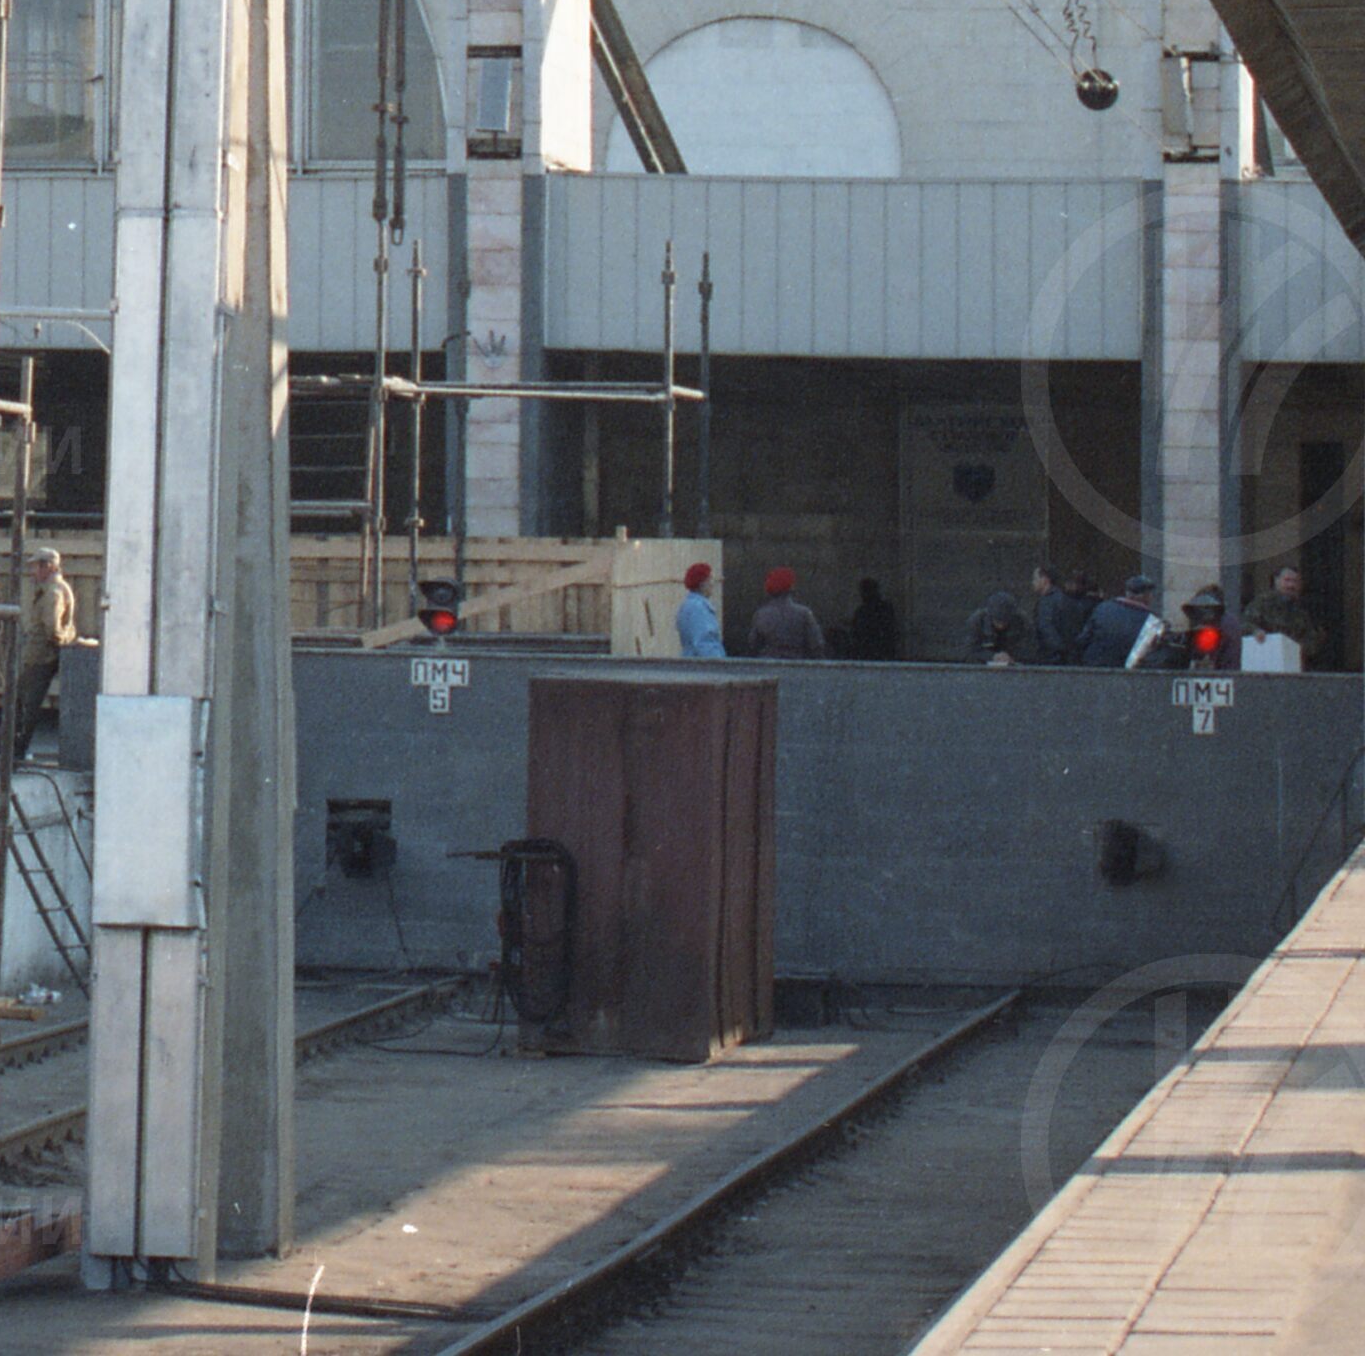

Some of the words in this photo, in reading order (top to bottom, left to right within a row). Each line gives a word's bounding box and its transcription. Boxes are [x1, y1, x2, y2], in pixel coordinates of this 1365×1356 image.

[414, 661, 466, 683] ПМЧ
[432, 688, 446, 710] 5
[1175, 681, 1230, 704] ПМЧ
[1197, 709, 1211, 731] 7
